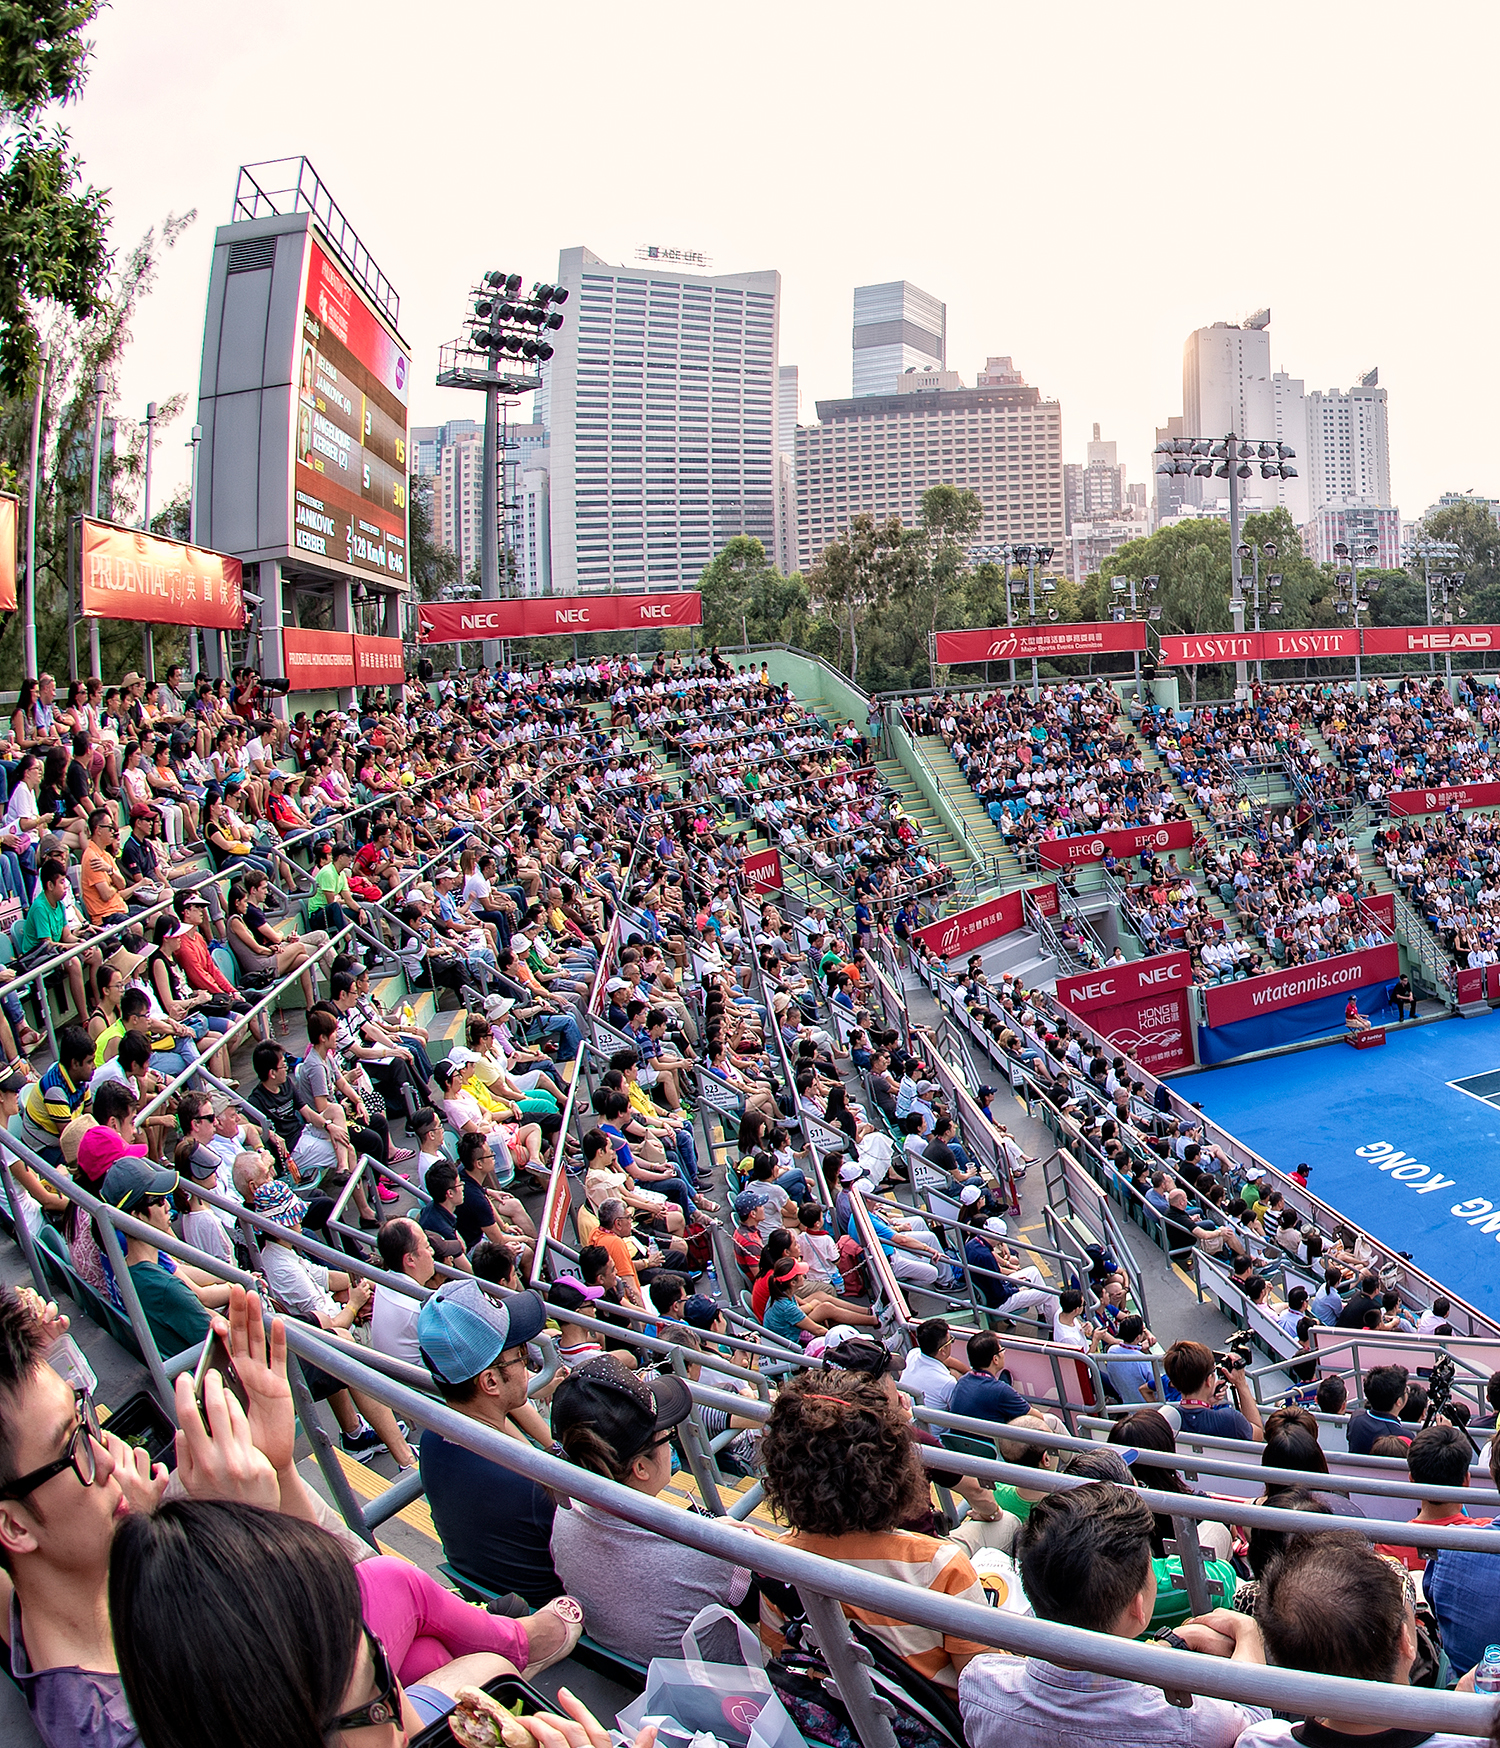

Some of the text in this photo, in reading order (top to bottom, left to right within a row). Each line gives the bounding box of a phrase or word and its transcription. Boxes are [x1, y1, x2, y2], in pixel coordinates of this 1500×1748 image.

[662, 249, 703, 262] ACE LIFE
[303, 312, 320, 339] Fault
[315, 374, 343, 409] JANKOVIC
[313, 411, 351, 450] ANGELIQUE
[365, 411, 372, 435] 3
[313, 431, 338, 463] KERBER
[394, 438, 405, 463] 15
[363, 463, 371, 489] 5
[393, 481, 405, 509] 30
[295, 505, 352, 543] JANKOVIC 2
[296, 528, 352, 564] KERBER 3
[353, 534, 386, 566] 128 Km/h
[387, 550, 404, 574] 0:46
[90, 553, 169, 597] PRUDENTIAL
[461, 604, 671, 630] NEC NEC NEC
[1021, 642, 1103, 653] Major Sports Events Committee
[1182, 635, 1344, 659] LASVIT LASVIT
[1408, 632, 1491, 649] HEAD
[1068, 834, 1156, 858] EFG EFG
[748, 863, 775, 884] BMW
[961, 911, 1003, 937] 大型體育活動
[1069, 963, 1182, 1004] NEC NEC
[1252, 963, 1362, 1006] wtatennis.com
[1137, 1004, 1170, 1020] HONG
[1139, 1013, 1171, 1030] KONG
[598, 1035, 613, 1044] S23
[1366, 1033, 1383, 1041] lotto
[704, 1084, 719, 1093] S23
[809, 1128, 824, 1138] S11
[914, 1166, 928, 1176] S11
[1355, 1140, 1456, 1195] KONG
